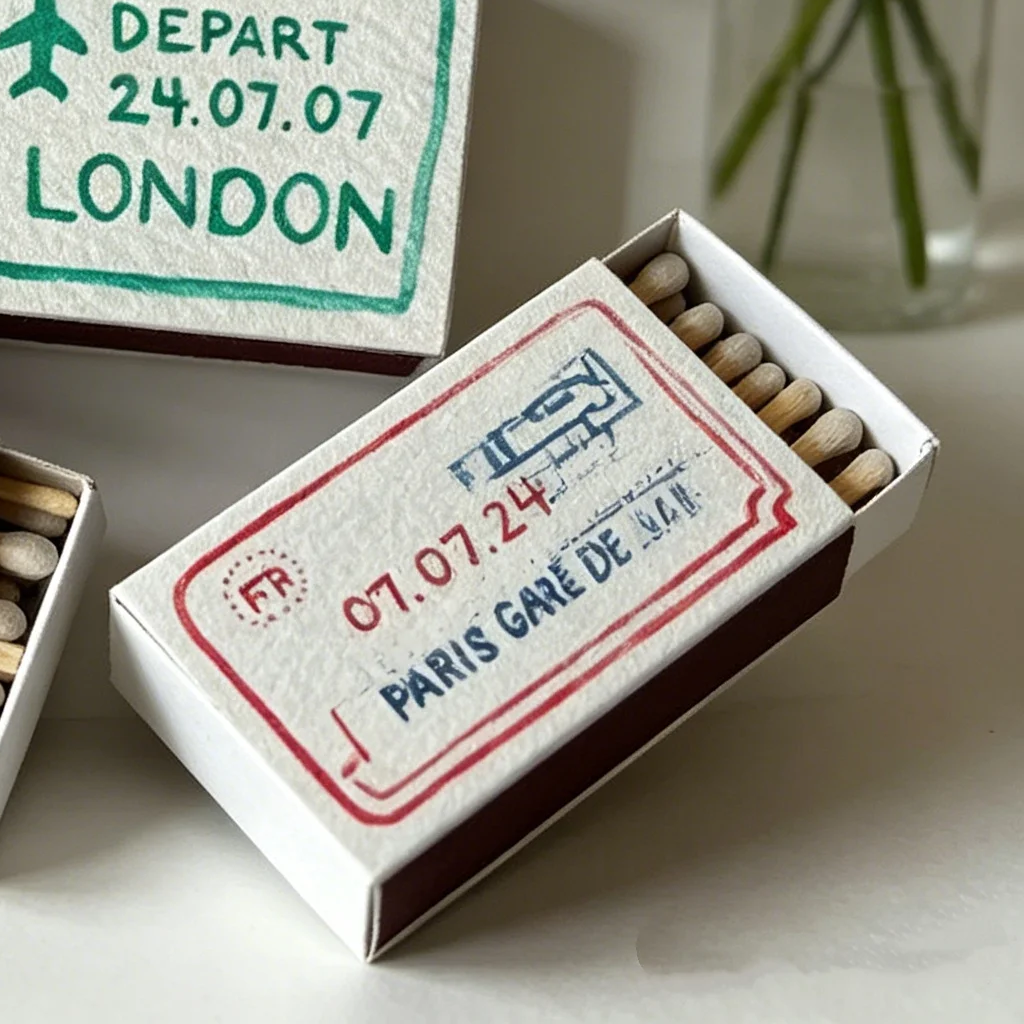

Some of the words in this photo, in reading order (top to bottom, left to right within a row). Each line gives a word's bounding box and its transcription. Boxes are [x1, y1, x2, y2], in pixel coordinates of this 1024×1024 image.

[112, 1, 348, 64] DEPART
[108, 74, 383, 140] 24.07.07
[26, 145, 396, 254] LONDON
[238, 566, 295, 614] FR
[343, 476, 552, 632] 07.07.24
[379, 626, 499, 722] PARIS
[494, 560, 586, 639] GARE
[576, 528, 632, 584] DE
